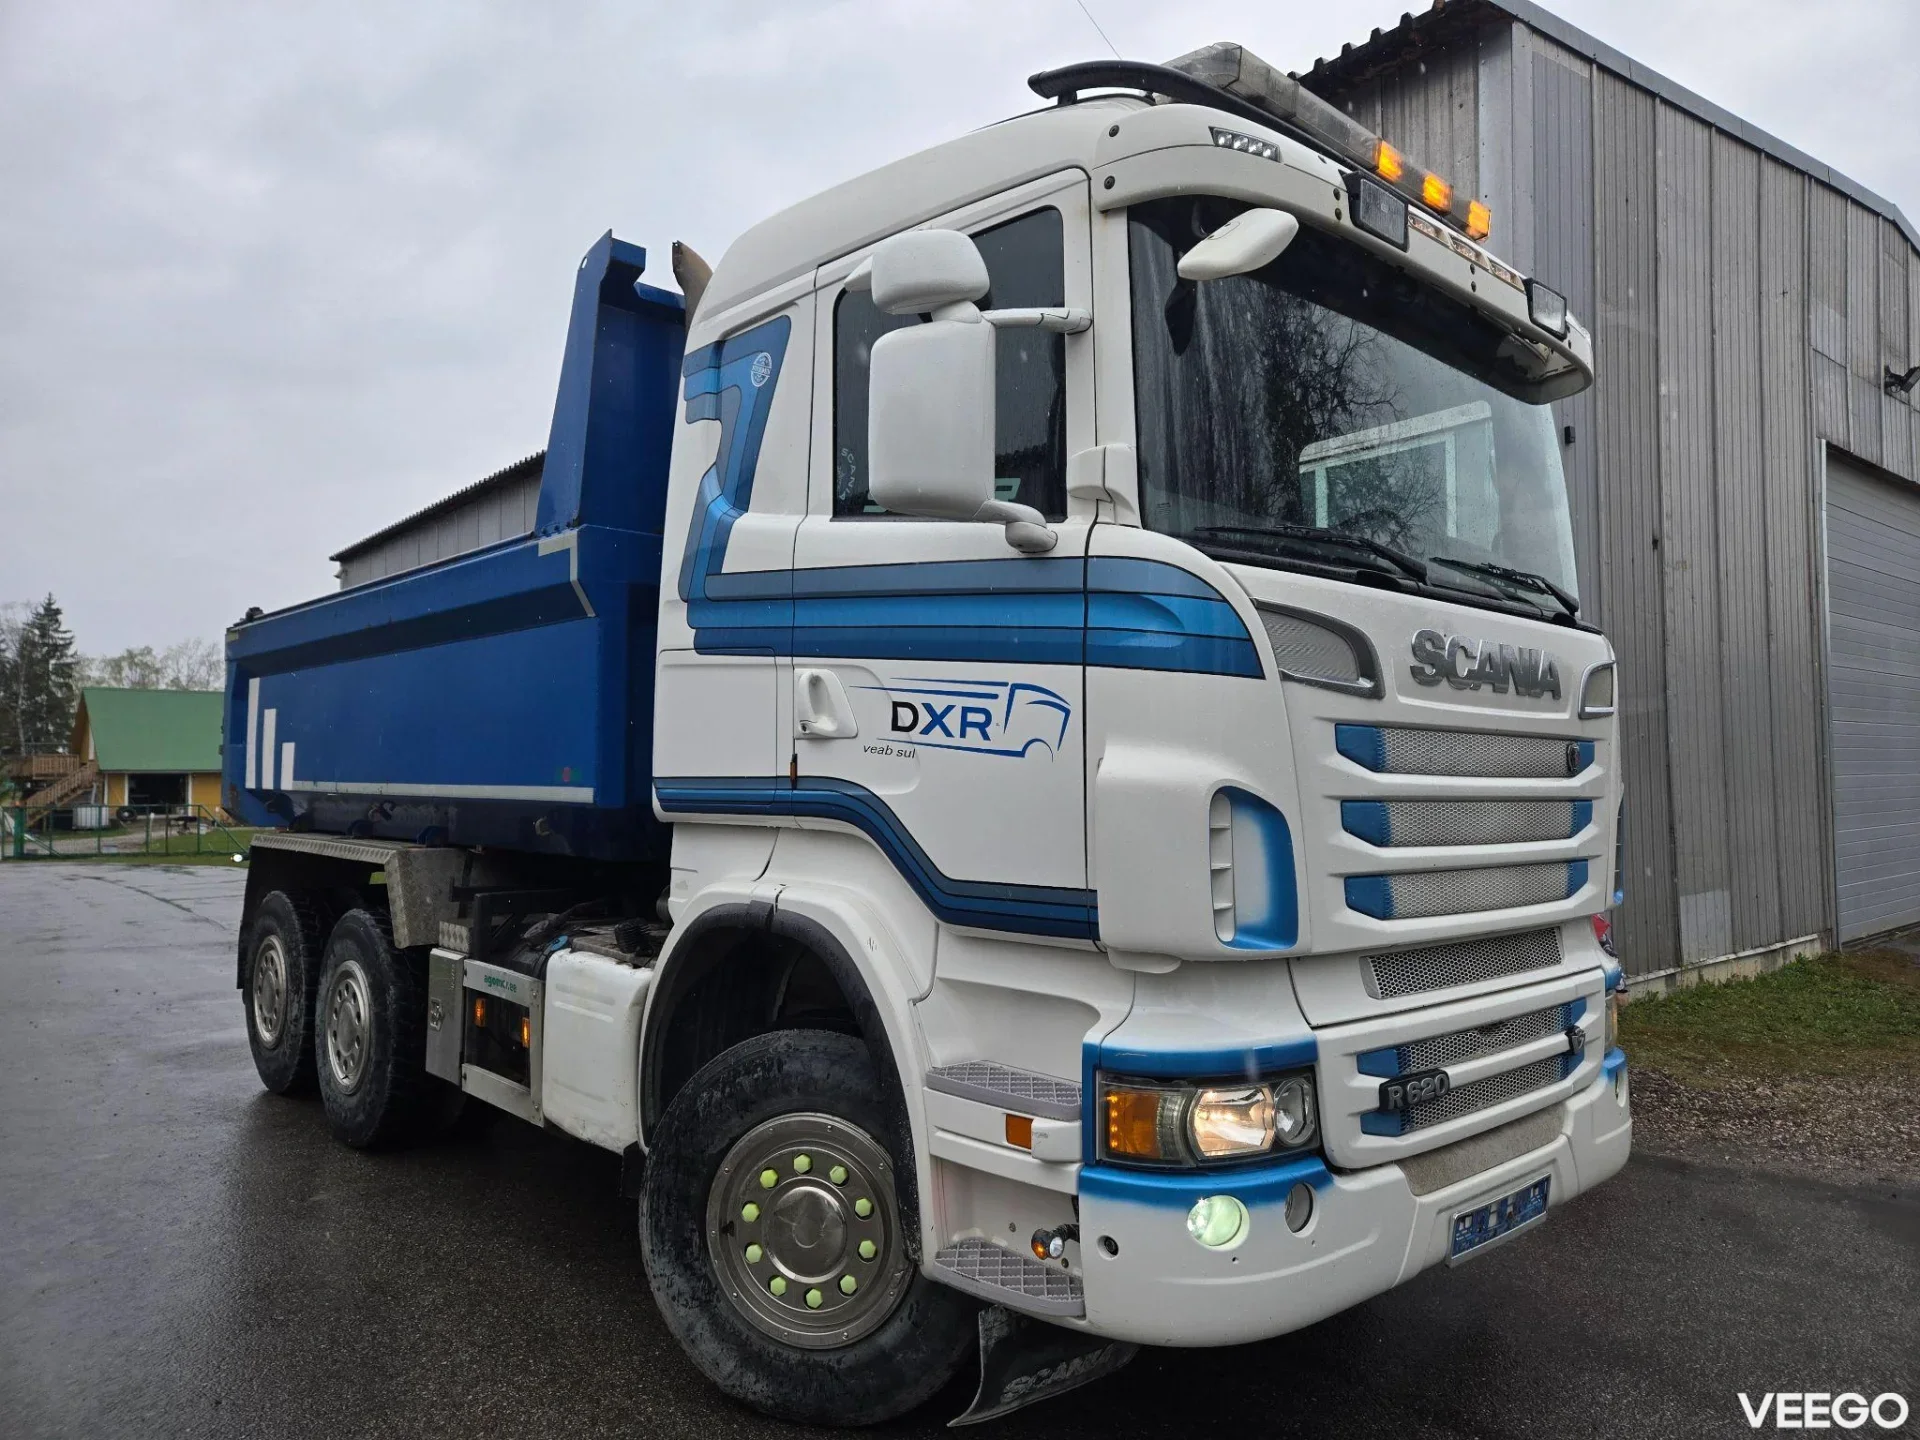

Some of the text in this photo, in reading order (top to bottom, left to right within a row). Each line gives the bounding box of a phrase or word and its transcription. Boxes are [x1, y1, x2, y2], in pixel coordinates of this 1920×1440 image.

[1409, 628, 1562, 701] SCANIA
[890, 700, 993, 742] DXR
[863, 744, 916, 759] veab sul
[1387, 1073, 1449, 1110] R 620
